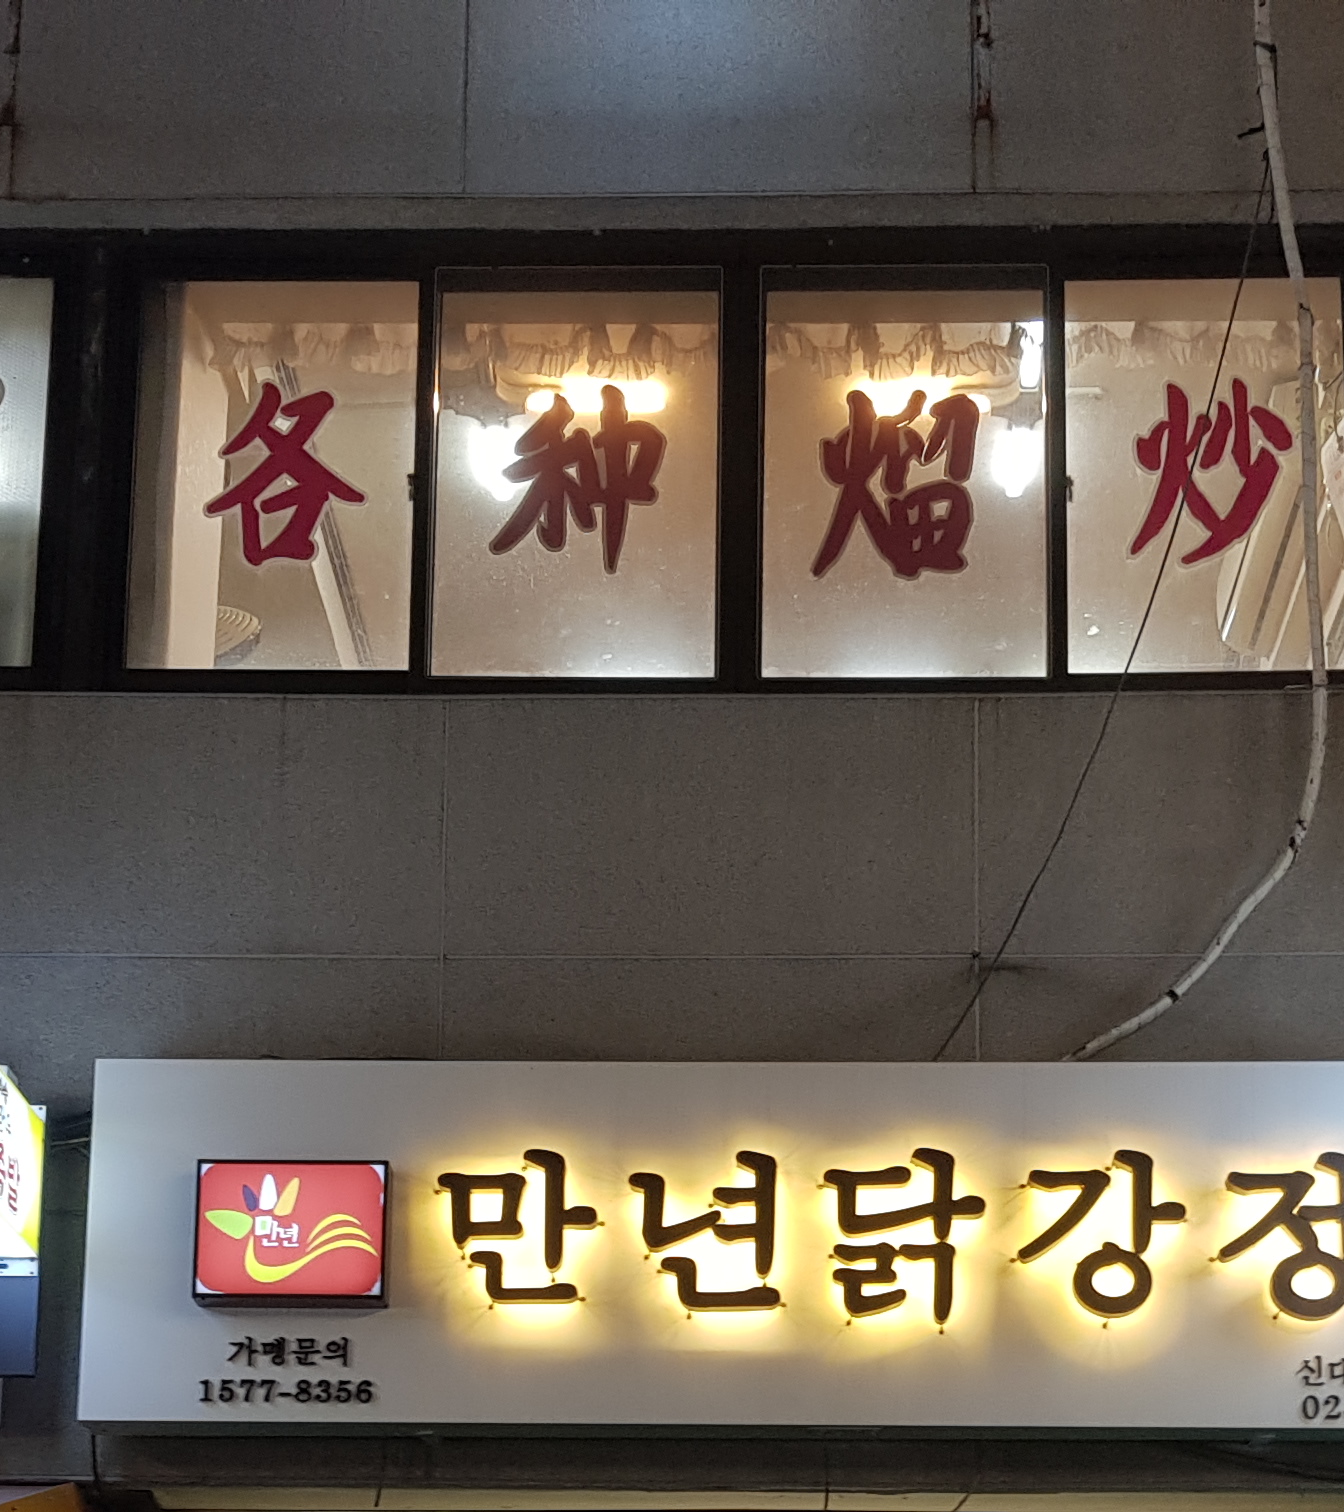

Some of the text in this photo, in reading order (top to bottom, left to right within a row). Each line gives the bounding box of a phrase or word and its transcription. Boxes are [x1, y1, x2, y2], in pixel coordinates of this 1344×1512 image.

[254, 1213, 301, 1248] 만년
[226, 1335, 351, 1368] 가맹문의
[198, 1378, 374, 1404] 1577-8356
